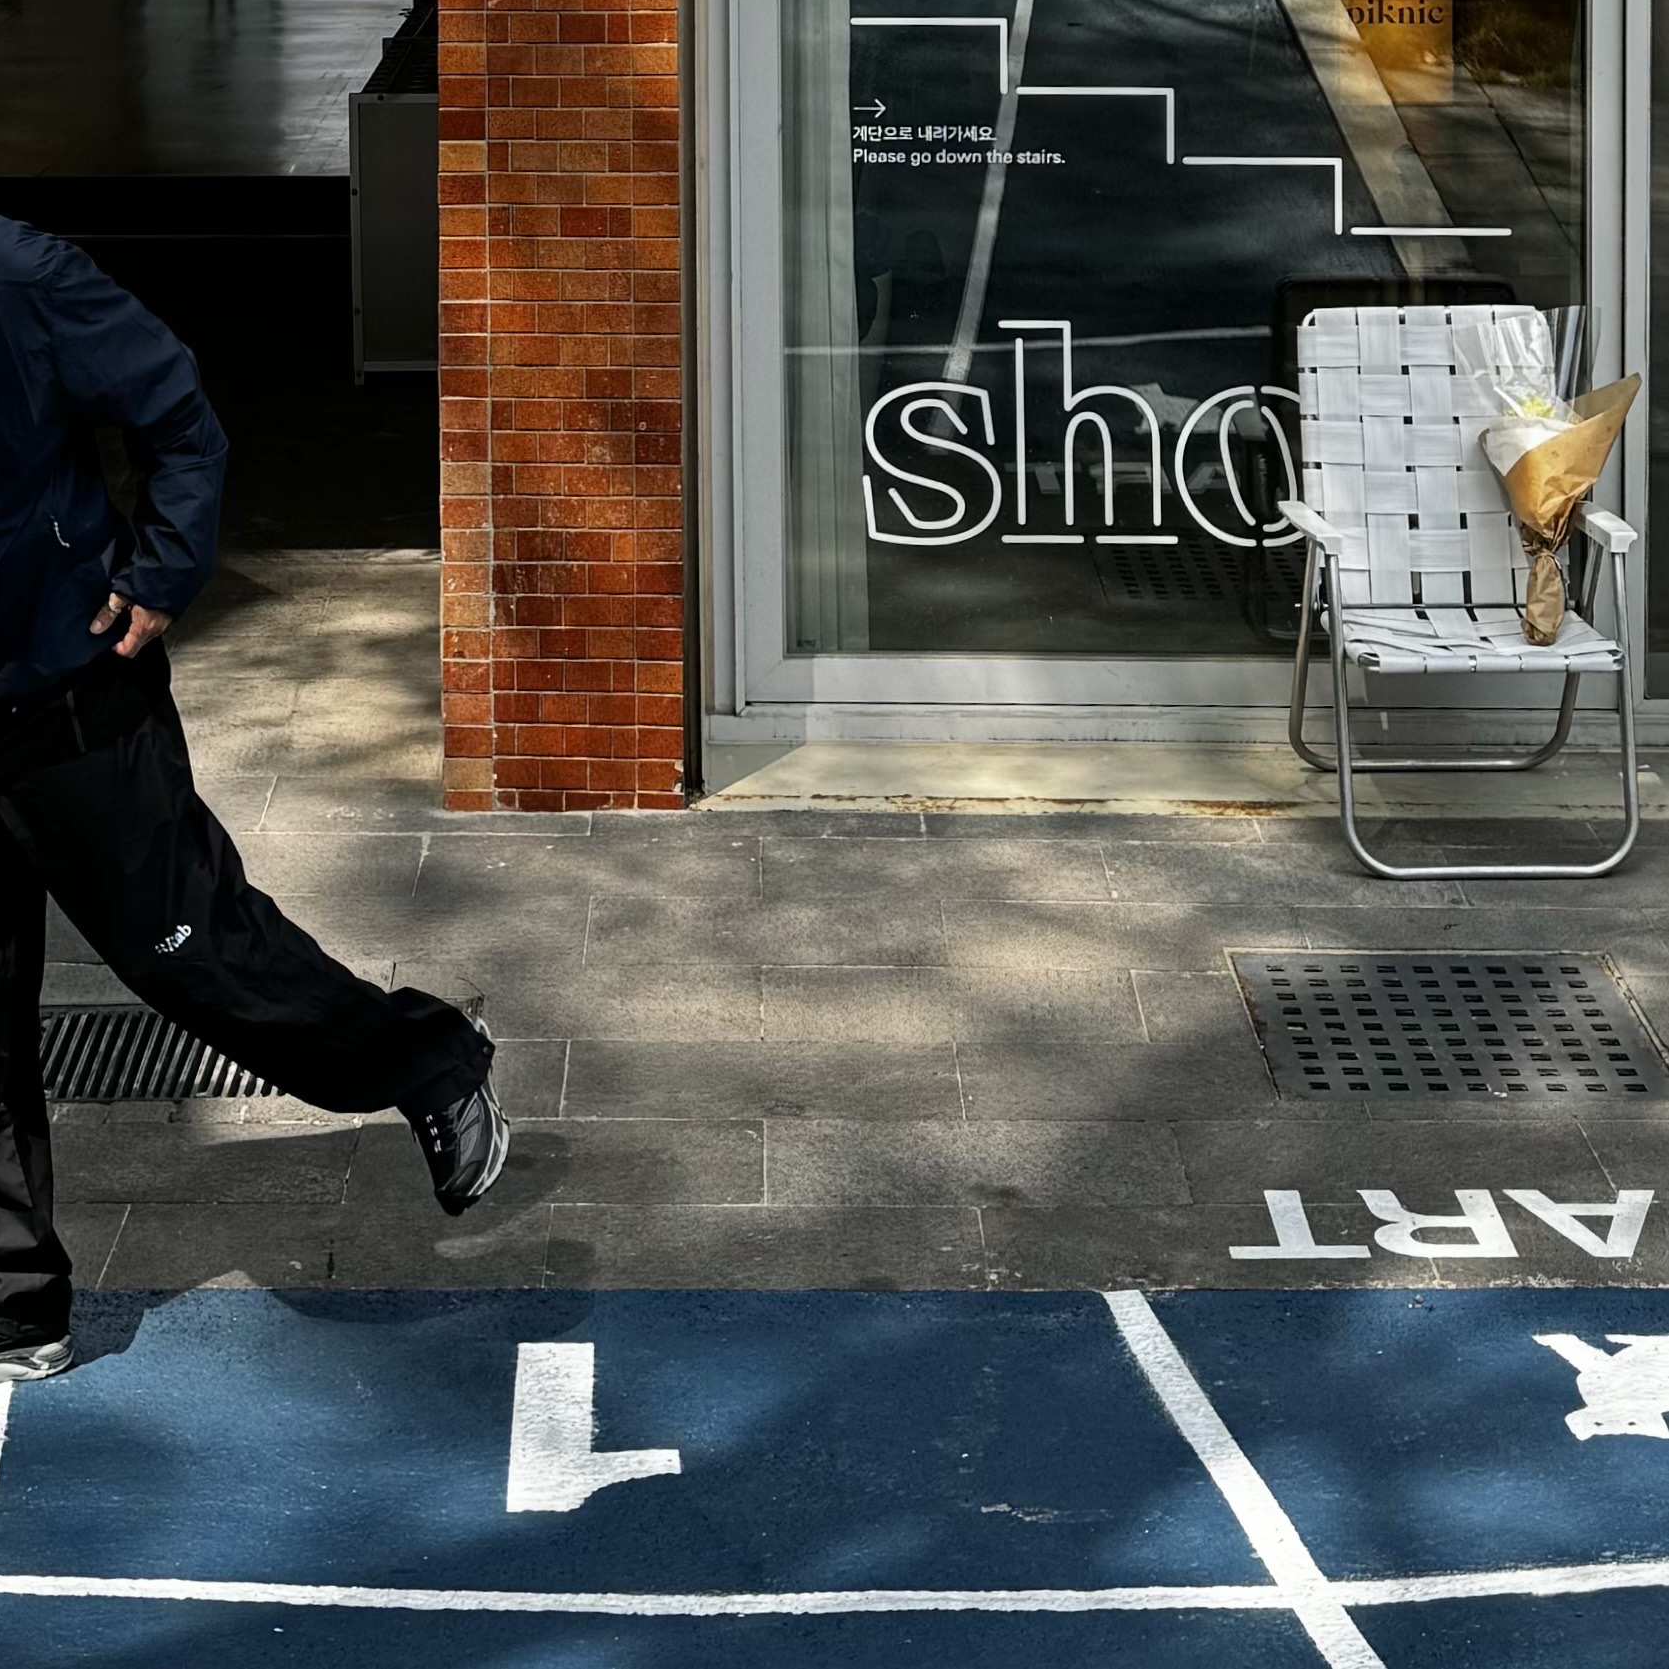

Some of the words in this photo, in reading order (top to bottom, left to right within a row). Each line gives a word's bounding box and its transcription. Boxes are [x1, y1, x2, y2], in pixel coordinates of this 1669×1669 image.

[852, 125, 914, 142] 계단으로
[852, 148, 906, 164] Please
[910, 151, 932, 167] go
[935, 148, 982, 164] down
[986, 149, 1013, 165] the
[1016, 149, 1066, 164] stairs.
[506, 1342, 682, 1513] 1
